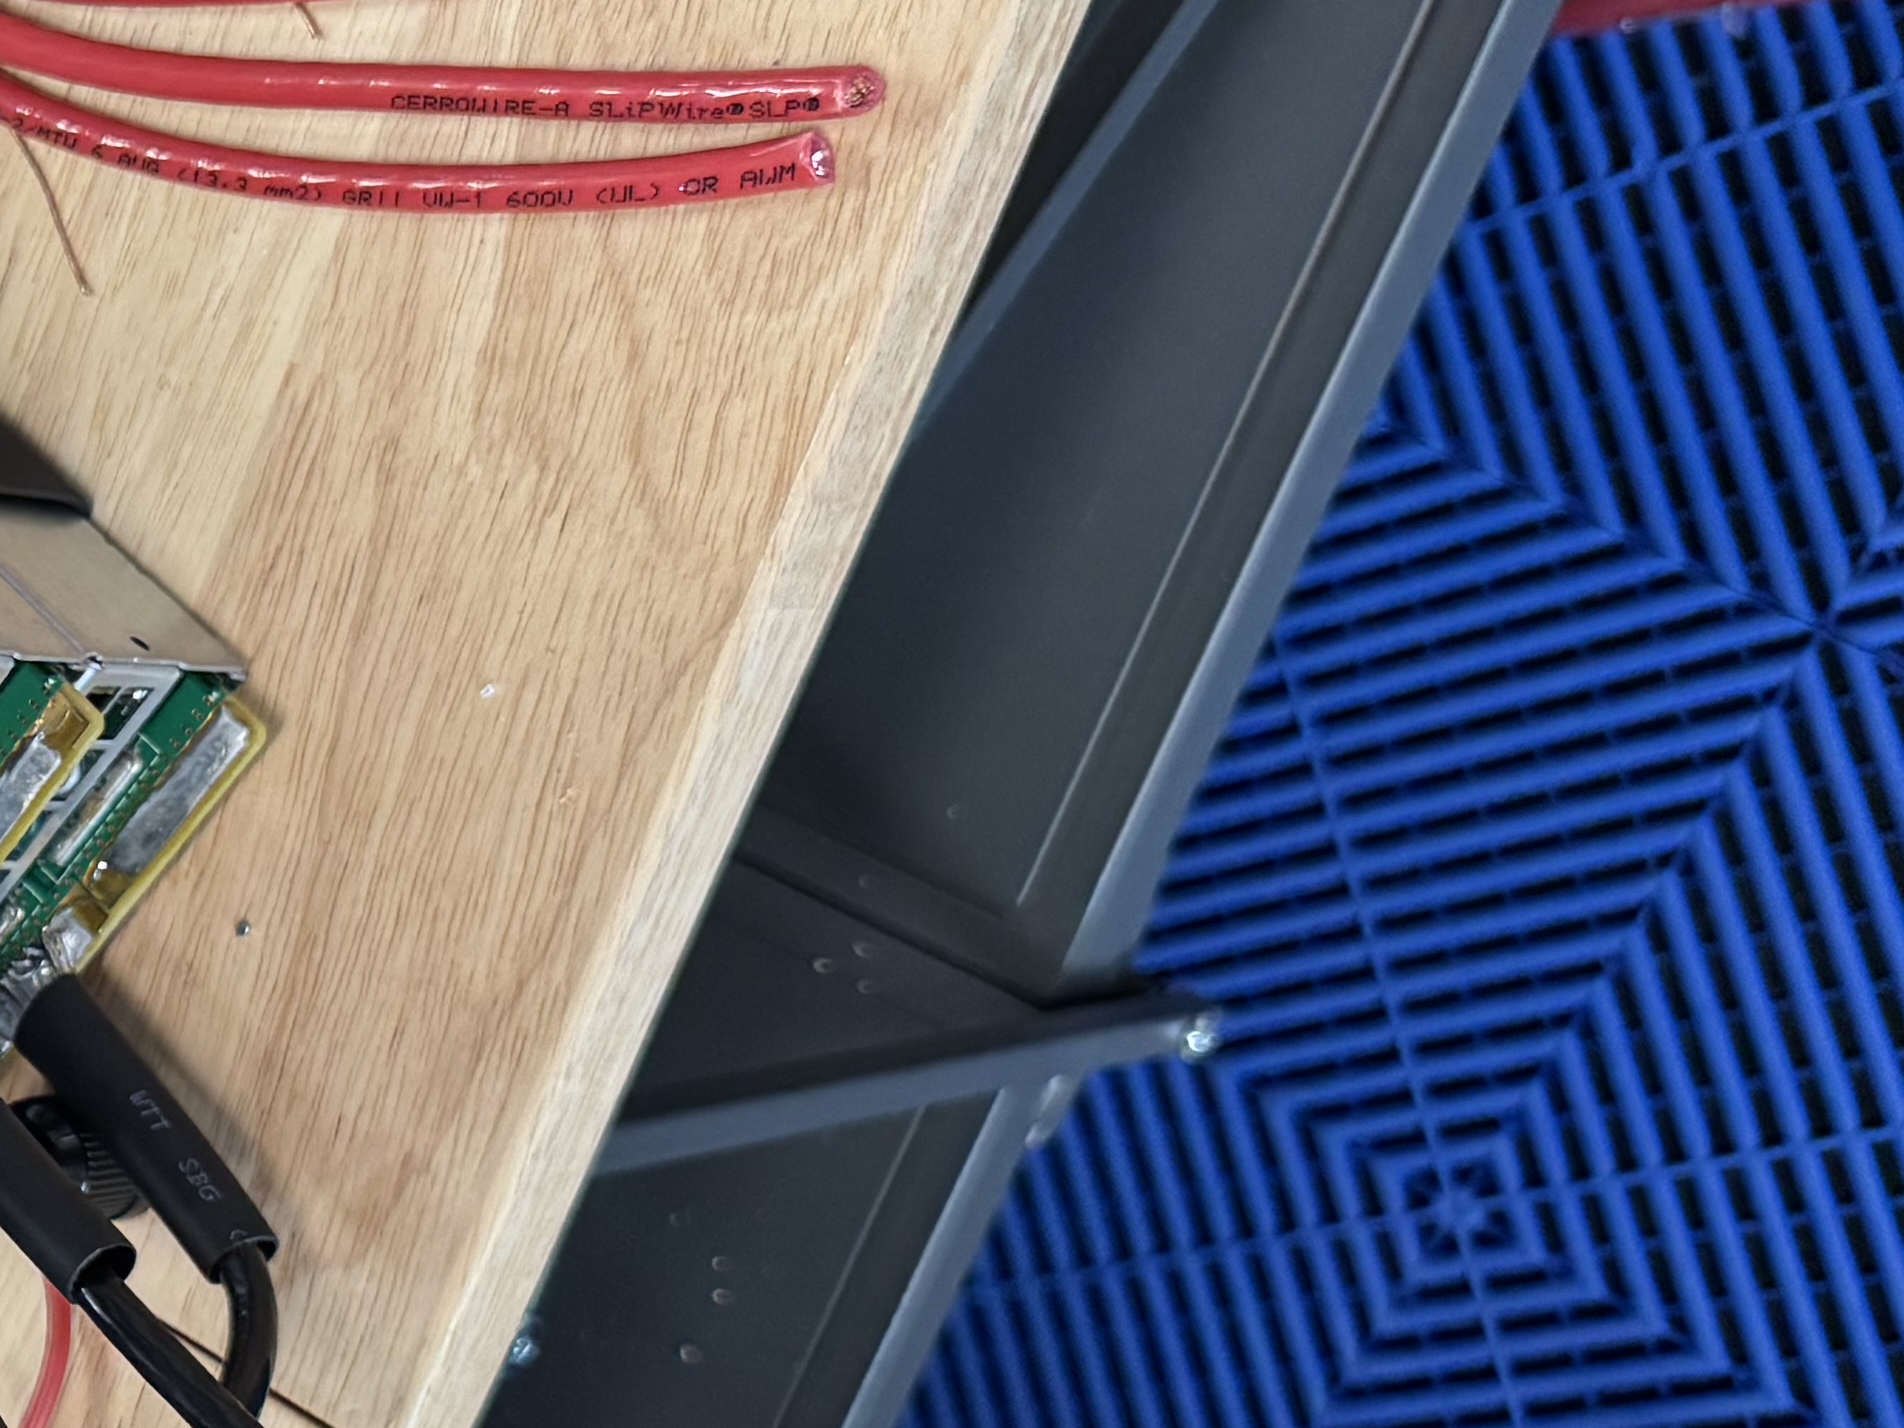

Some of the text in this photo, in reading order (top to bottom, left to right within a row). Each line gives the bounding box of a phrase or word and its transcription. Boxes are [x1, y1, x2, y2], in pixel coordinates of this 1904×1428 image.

[116, 152, 162, 176] AWG
[505, 188, 575, 209] 600V
[594, 182, 663, 206] (UL)
[679, 176, 720, 197] OR
[739, 162, 797, 189] AWM
